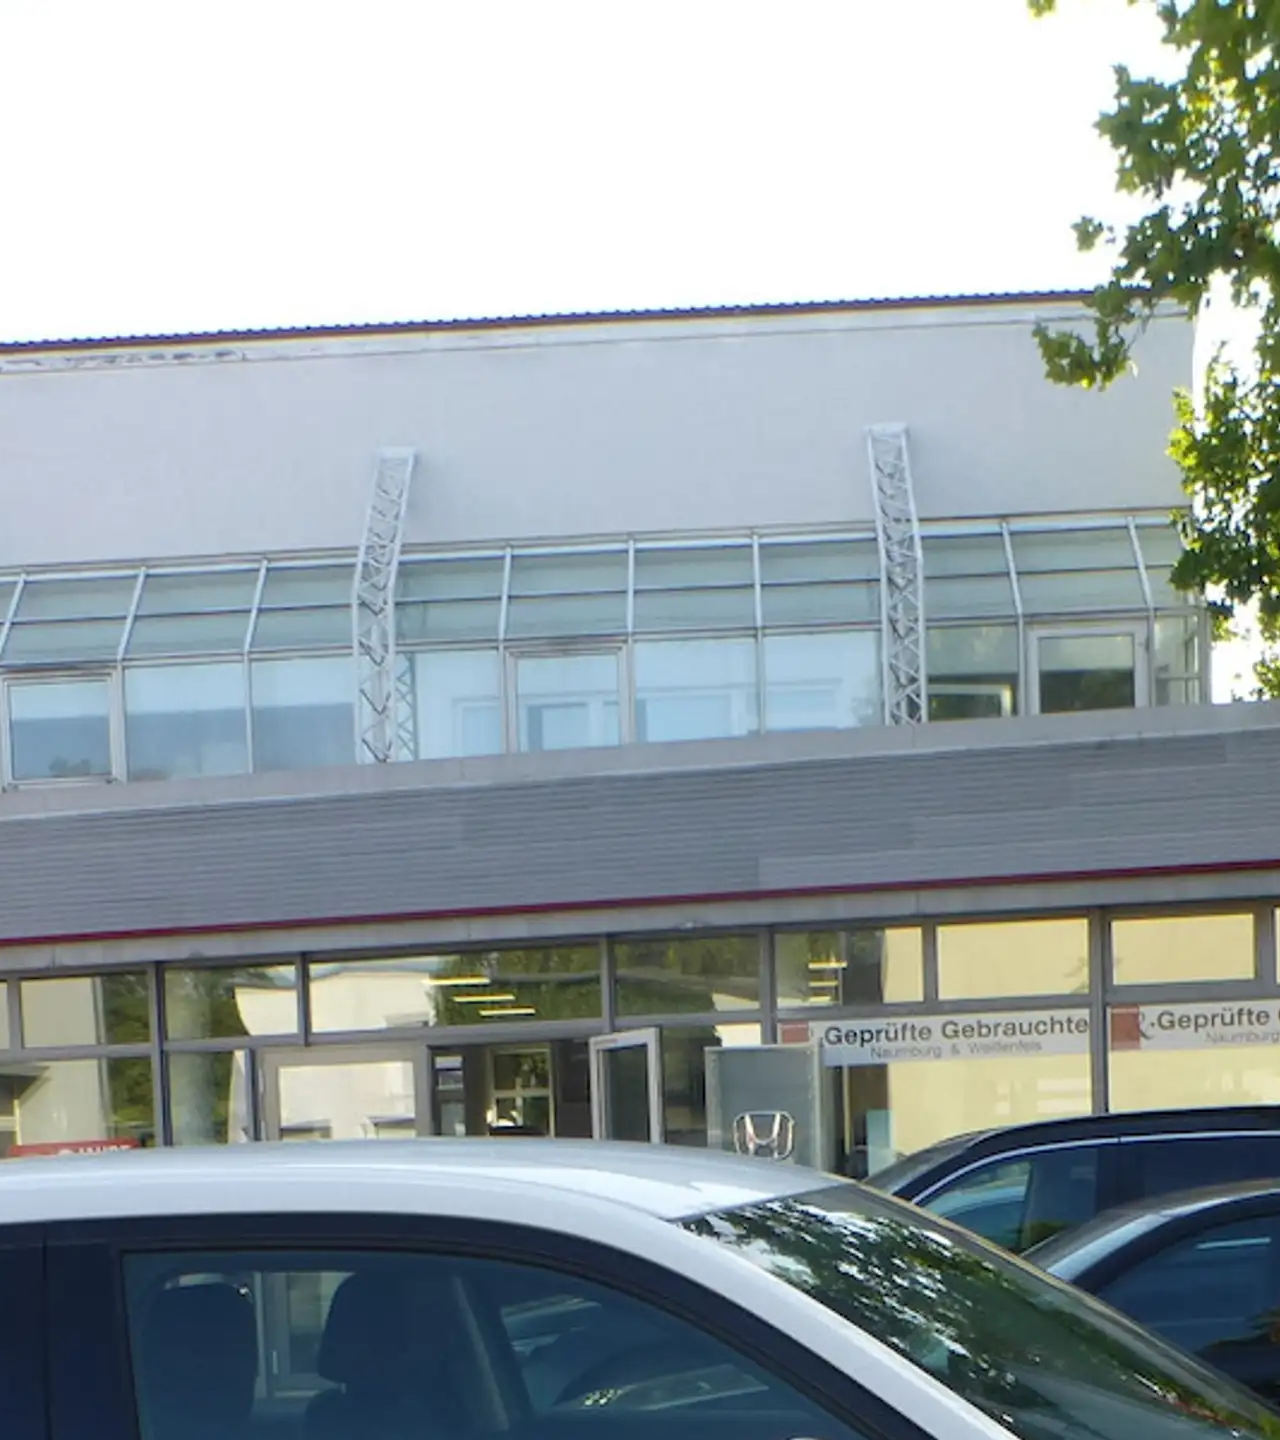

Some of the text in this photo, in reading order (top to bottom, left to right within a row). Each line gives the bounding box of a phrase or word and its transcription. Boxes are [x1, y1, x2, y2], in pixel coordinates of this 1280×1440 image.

[824, 1015, 1088, 1047] Geprüfte Gebrauchte
[1157, 1006, 1270, 1032] Geprüfte
